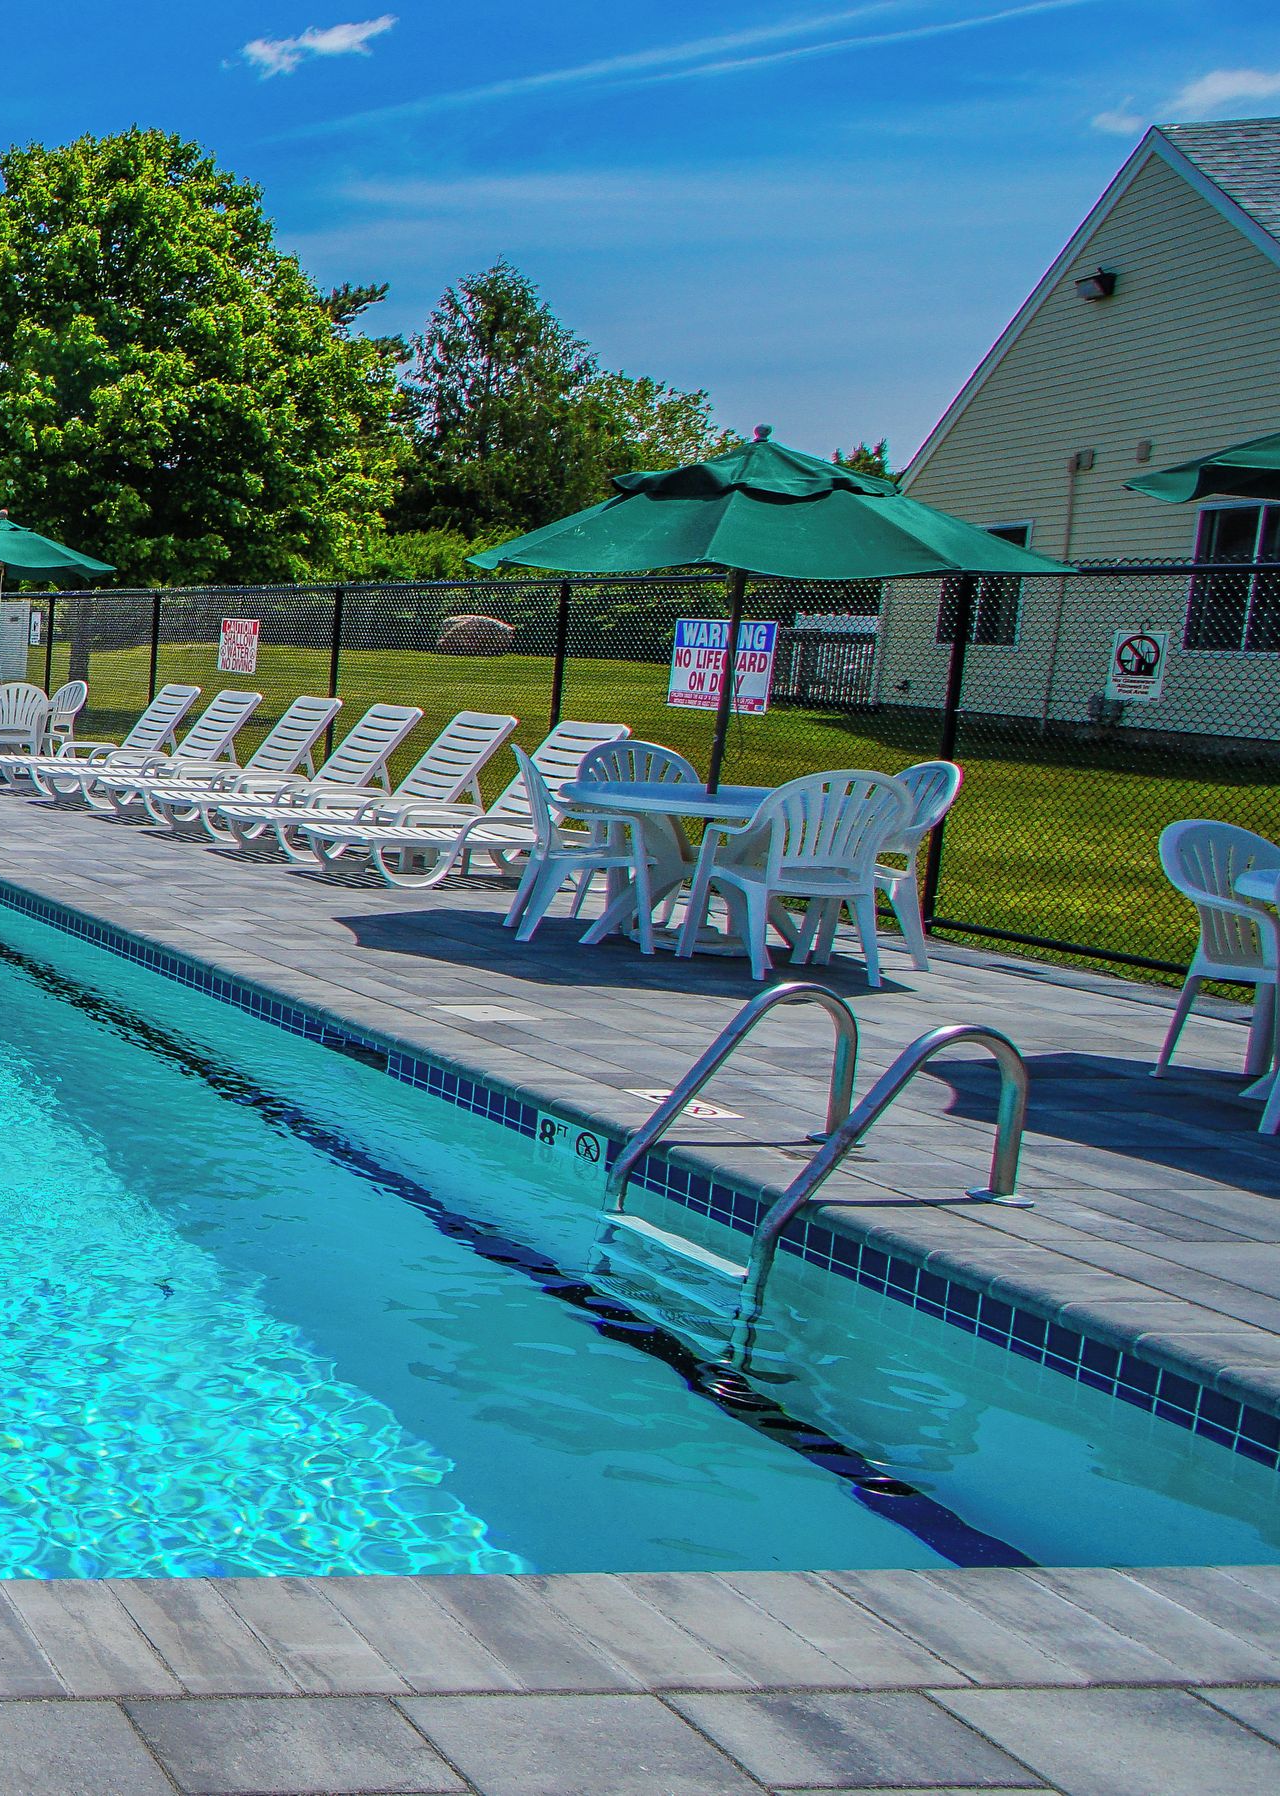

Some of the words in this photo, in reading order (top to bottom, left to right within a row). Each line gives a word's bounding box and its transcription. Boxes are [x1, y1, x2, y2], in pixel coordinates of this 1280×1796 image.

[225, 620, 253, 634] CAUTION
[682, 622, 767, 650] WARNNG
[224, 633, 254, 647] SHALLOW
[228, 646, 249, 659] WATER
[674, 648, 692, 668] NO
[696, 650, 768, 673] LIFEARD
[221, 657, 231, 670] NO
[232, 659, 252, 672] DIVING
[688, 671, 706, 691] ON
[708, 672, 745, 696] DY
[539, 1118, 556, 1146] 8
[556, 1124, 568, 1138] FT
